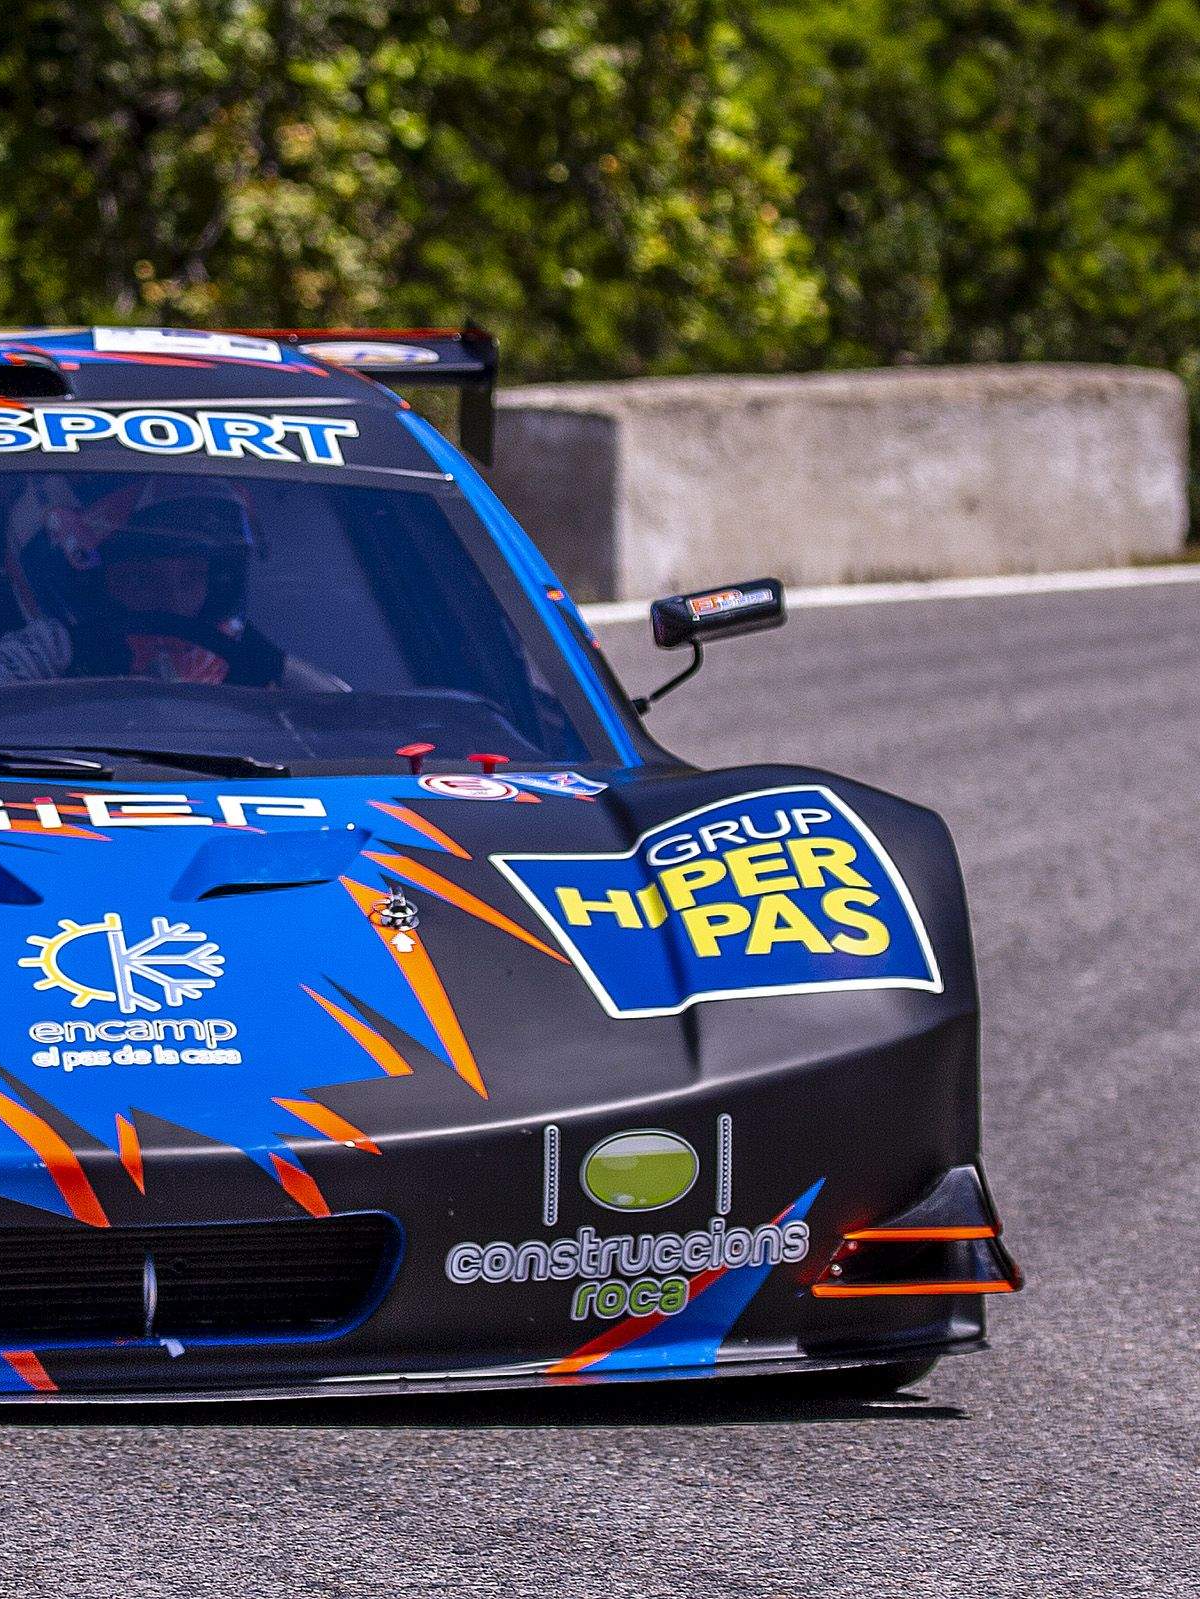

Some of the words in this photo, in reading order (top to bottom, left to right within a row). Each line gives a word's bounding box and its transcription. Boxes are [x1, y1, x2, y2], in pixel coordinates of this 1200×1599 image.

[645, 807, 833, 866] GRUP
[682, 887, 891, 958] PAS
[29, 1018, 238, 1050] encamp
[32, 1046, 60, 1067] el
[62, 1049, 112, 1072] pas
[112, 1044, 152, 1065] de
[153, 1044, 180, 1065] la
[180, 1048, 242, 1065] casa
[445, 1216, 810, 1284] construccions
[571, 1275, 690, 1320] roca
